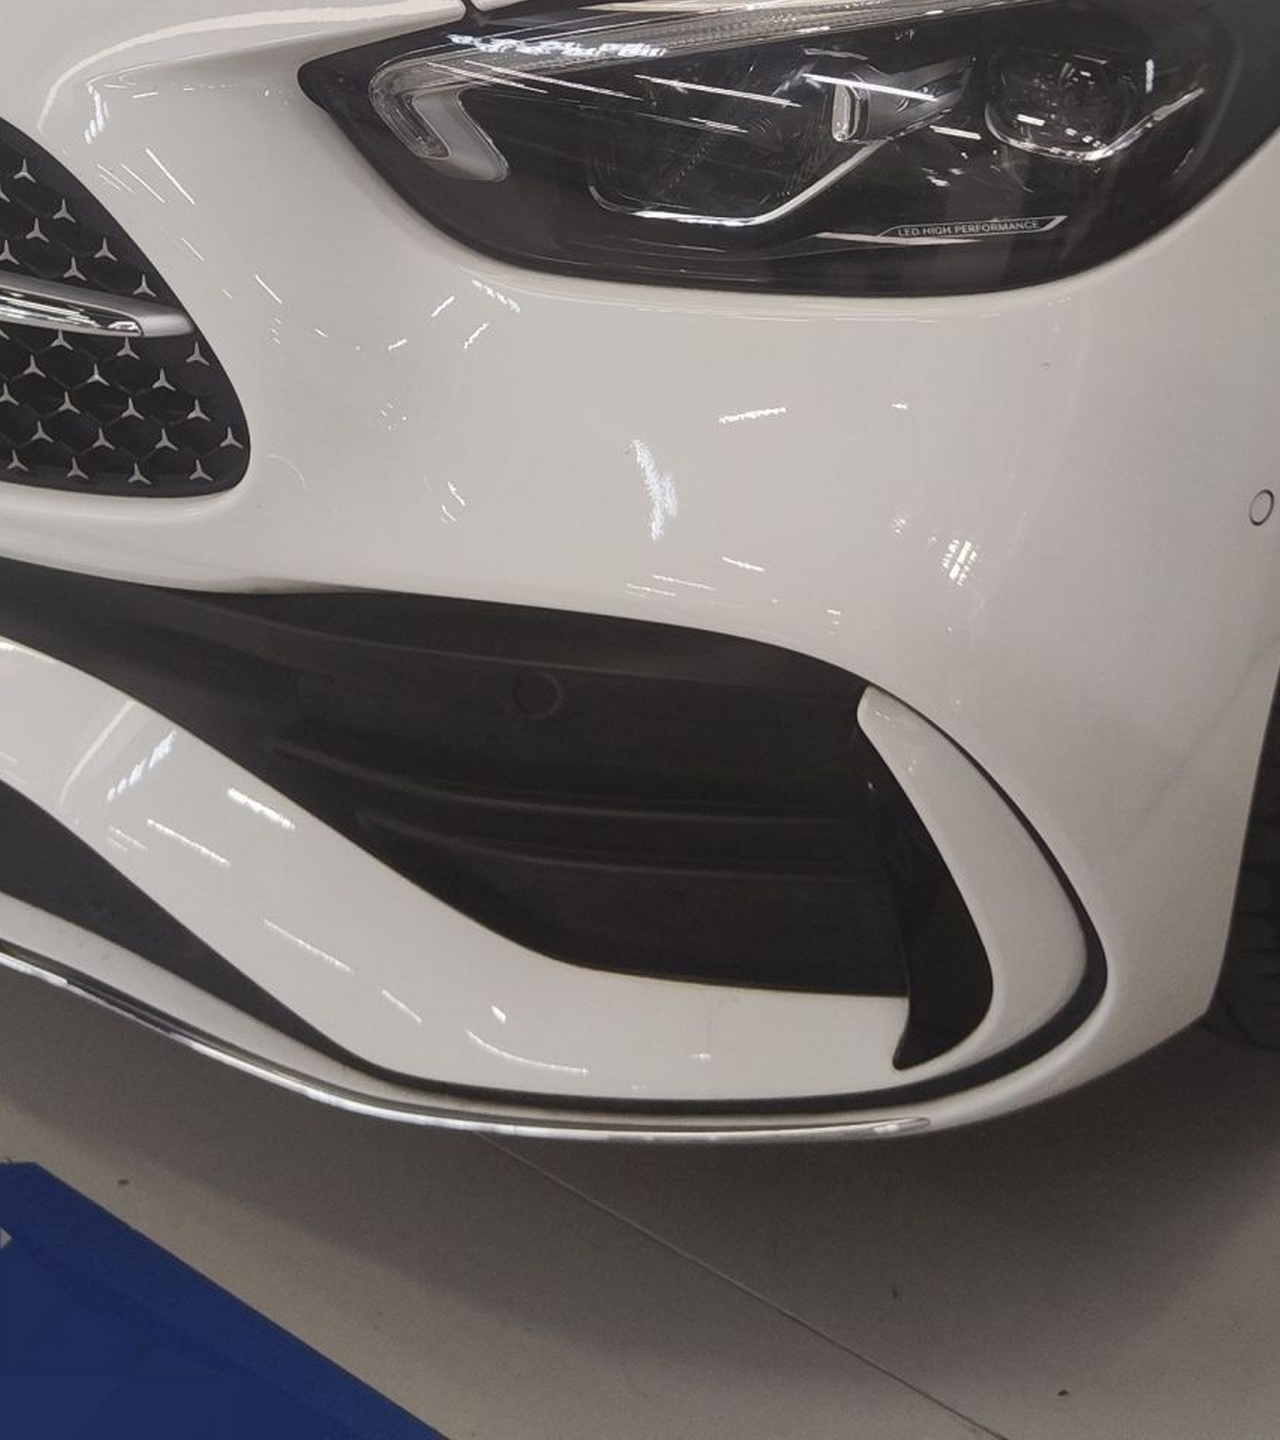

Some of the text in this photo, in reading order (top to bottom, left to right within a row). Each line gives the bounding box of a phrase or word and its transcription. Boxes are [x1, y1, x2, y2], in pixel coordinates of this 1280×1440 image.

[897, 220, 1040, 236] LED HIGH PERFORMANCE
